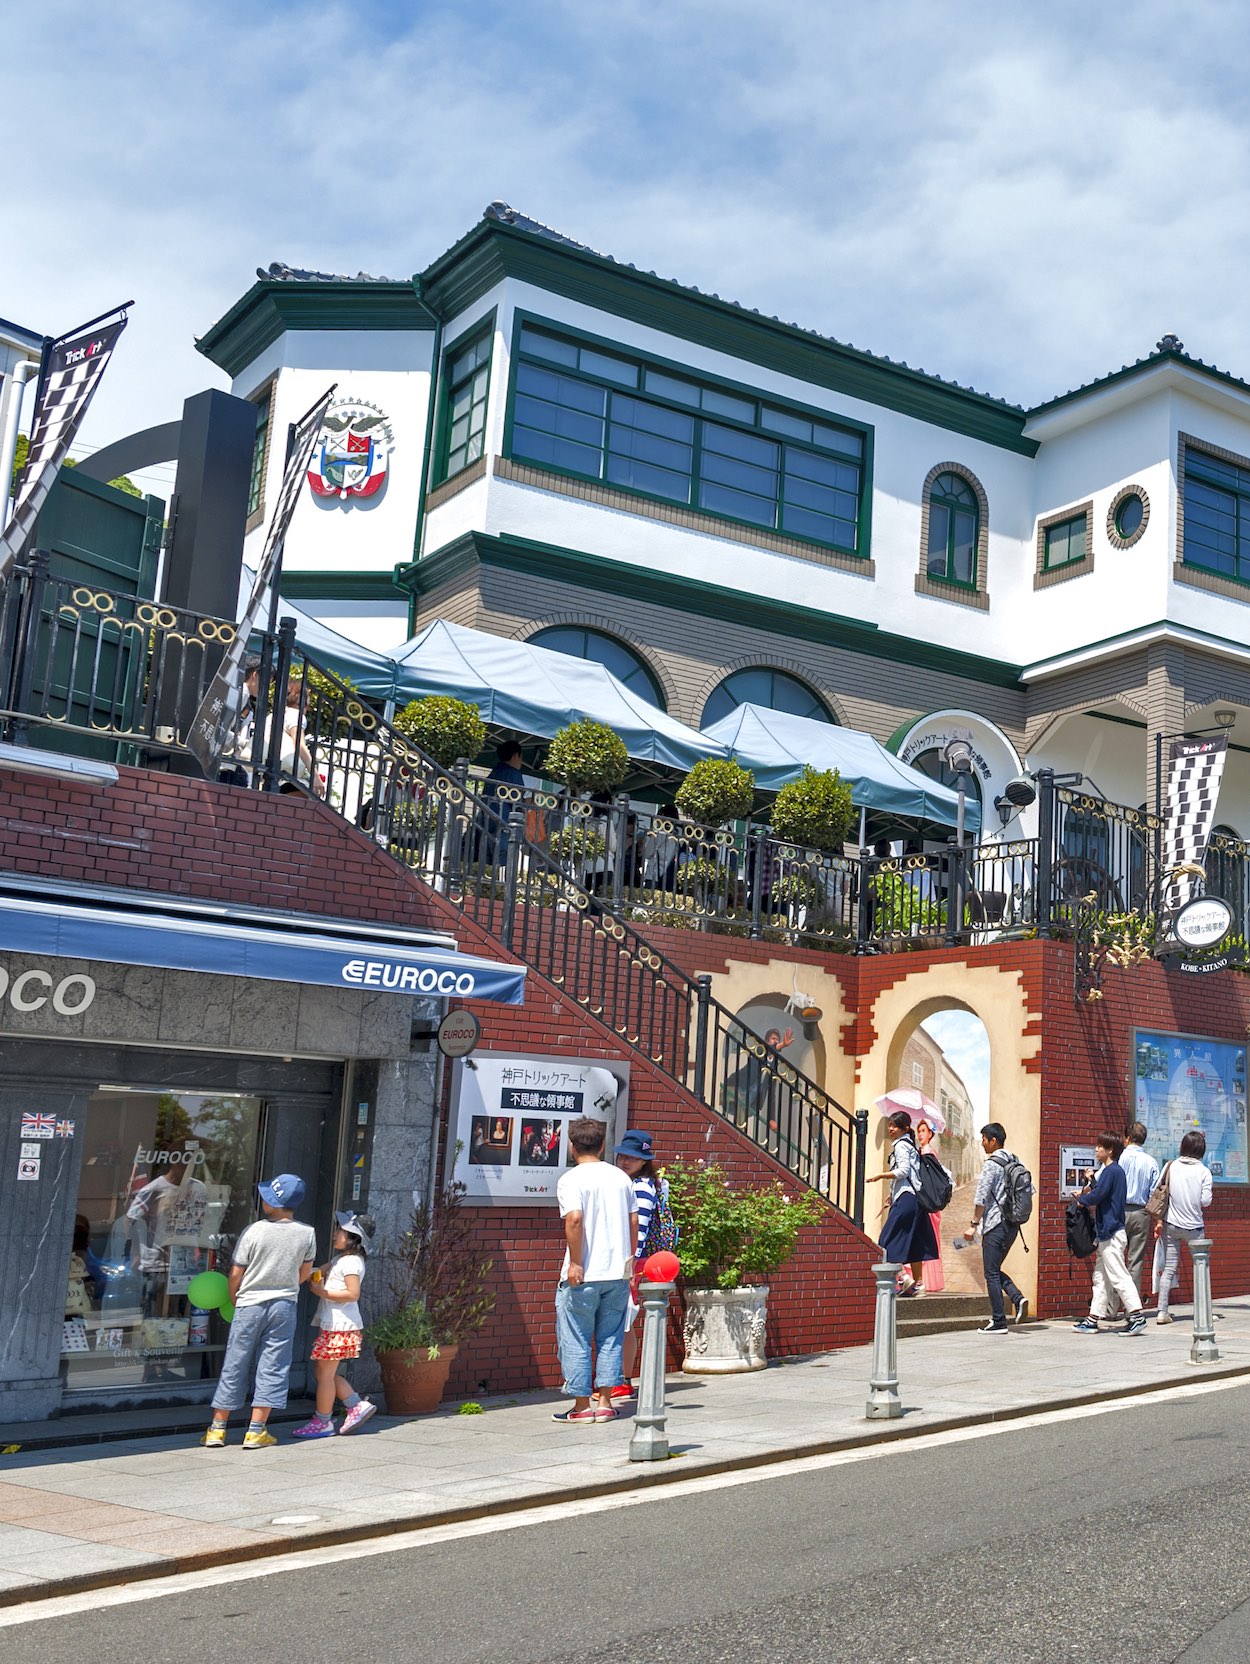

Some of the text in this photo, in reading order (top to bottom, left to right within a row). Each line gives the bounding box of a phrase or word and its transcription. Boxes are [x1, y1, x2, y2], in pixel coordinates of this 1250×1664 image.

[65, 340, 103, 365] Trick Art
[442, 1029, 475, 1040] EUROCO
[501, 1067, 586, 1088] 神戸トリックアート
[510, 1091, 575, 1109] 不思議な領事館
[134, 1150, 206, 1165] EUROCO
[113, 1348, 131, 1357] Gift
[143, 1346, 185, 1357] Souvenir
